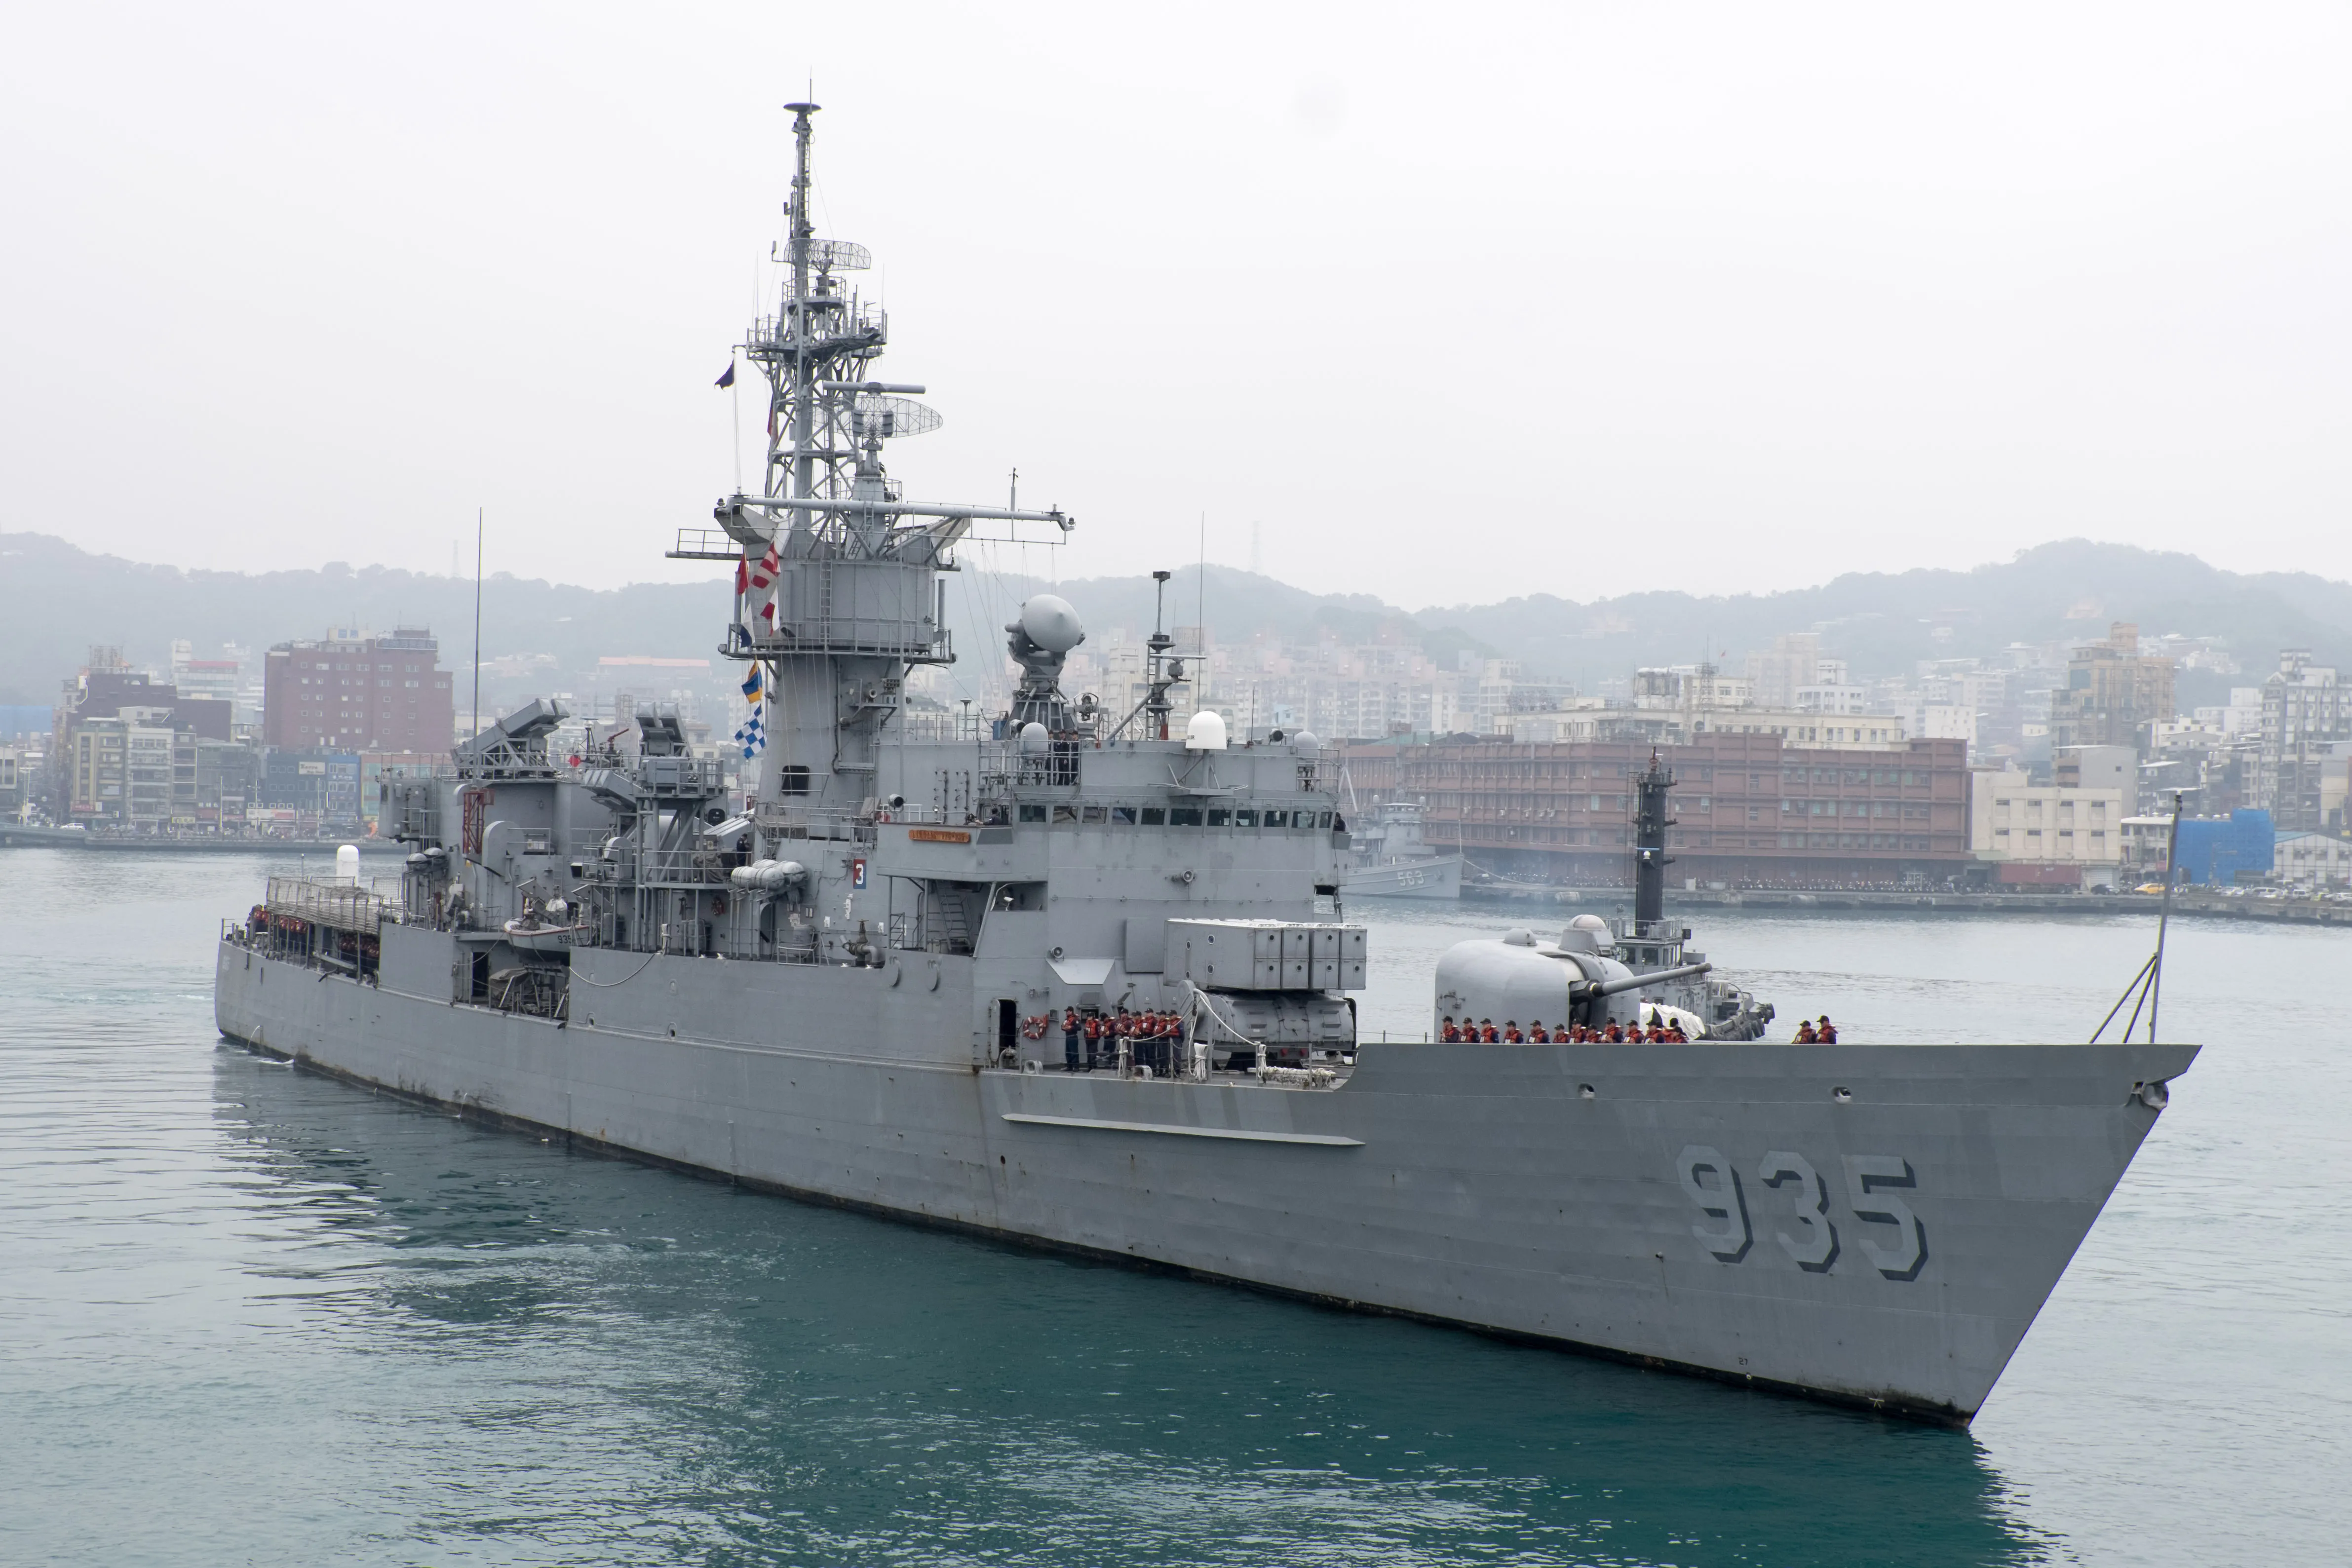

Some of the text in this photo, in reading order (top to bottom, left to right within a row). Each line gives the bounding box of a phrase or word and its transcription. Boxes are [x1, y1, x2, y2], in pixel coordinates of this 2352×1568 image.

[856, 864, 864, 884] 3
[1397, 870, 1425, 886] 563
[1676, 1144, 1928, 1281] 935
[1738, 1357, 1748, 1366] 27
